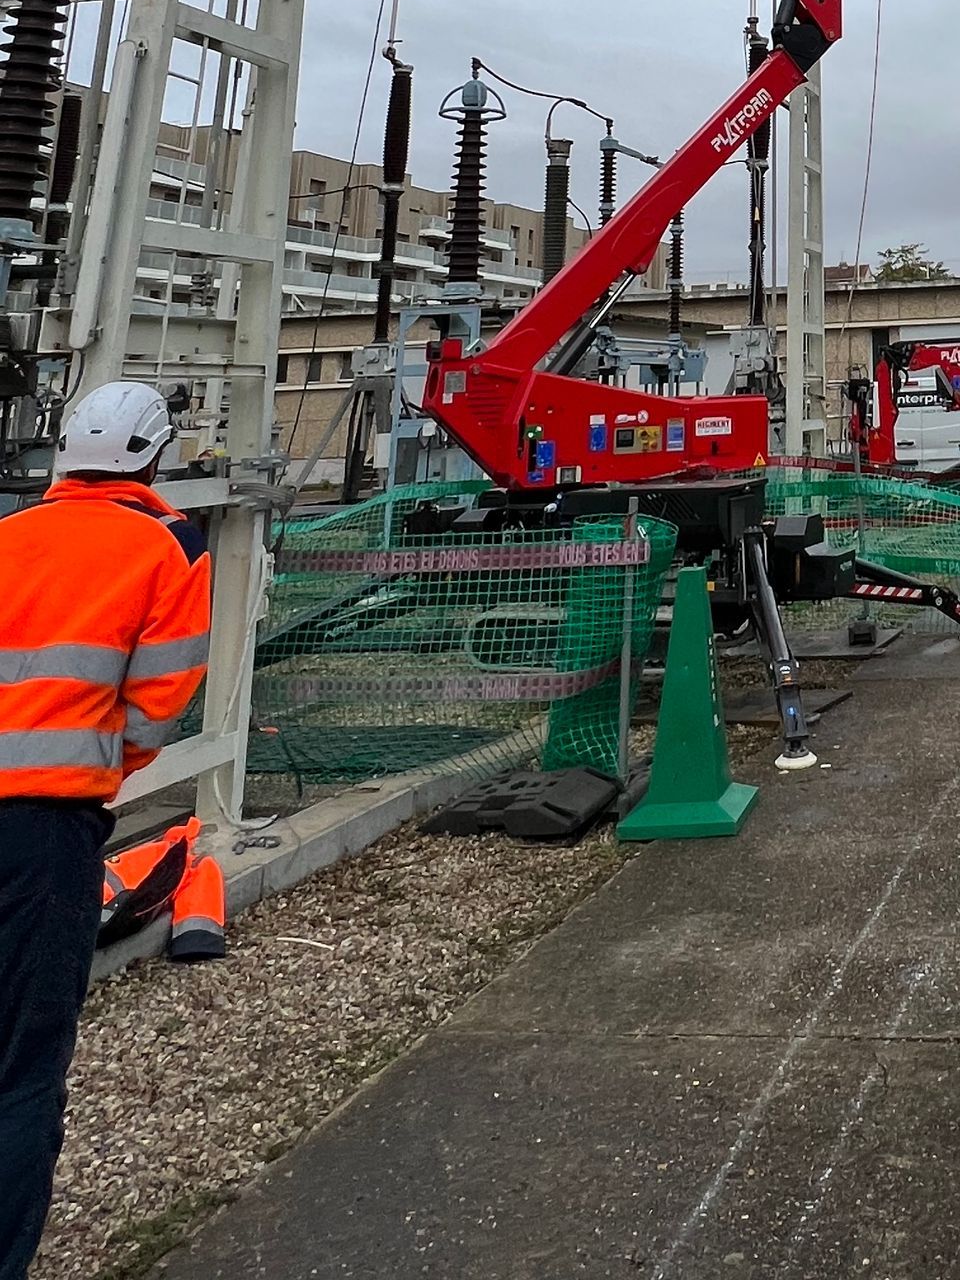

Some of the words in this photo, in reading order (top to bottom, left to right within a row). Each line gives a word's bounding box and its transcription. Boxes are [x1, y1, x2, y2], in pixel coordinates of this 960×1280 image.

[710, 87, 772, 152] PLATFORM
[897, 394, 943, 405] nterpr
[558, 544, 587, 565] VOUS
